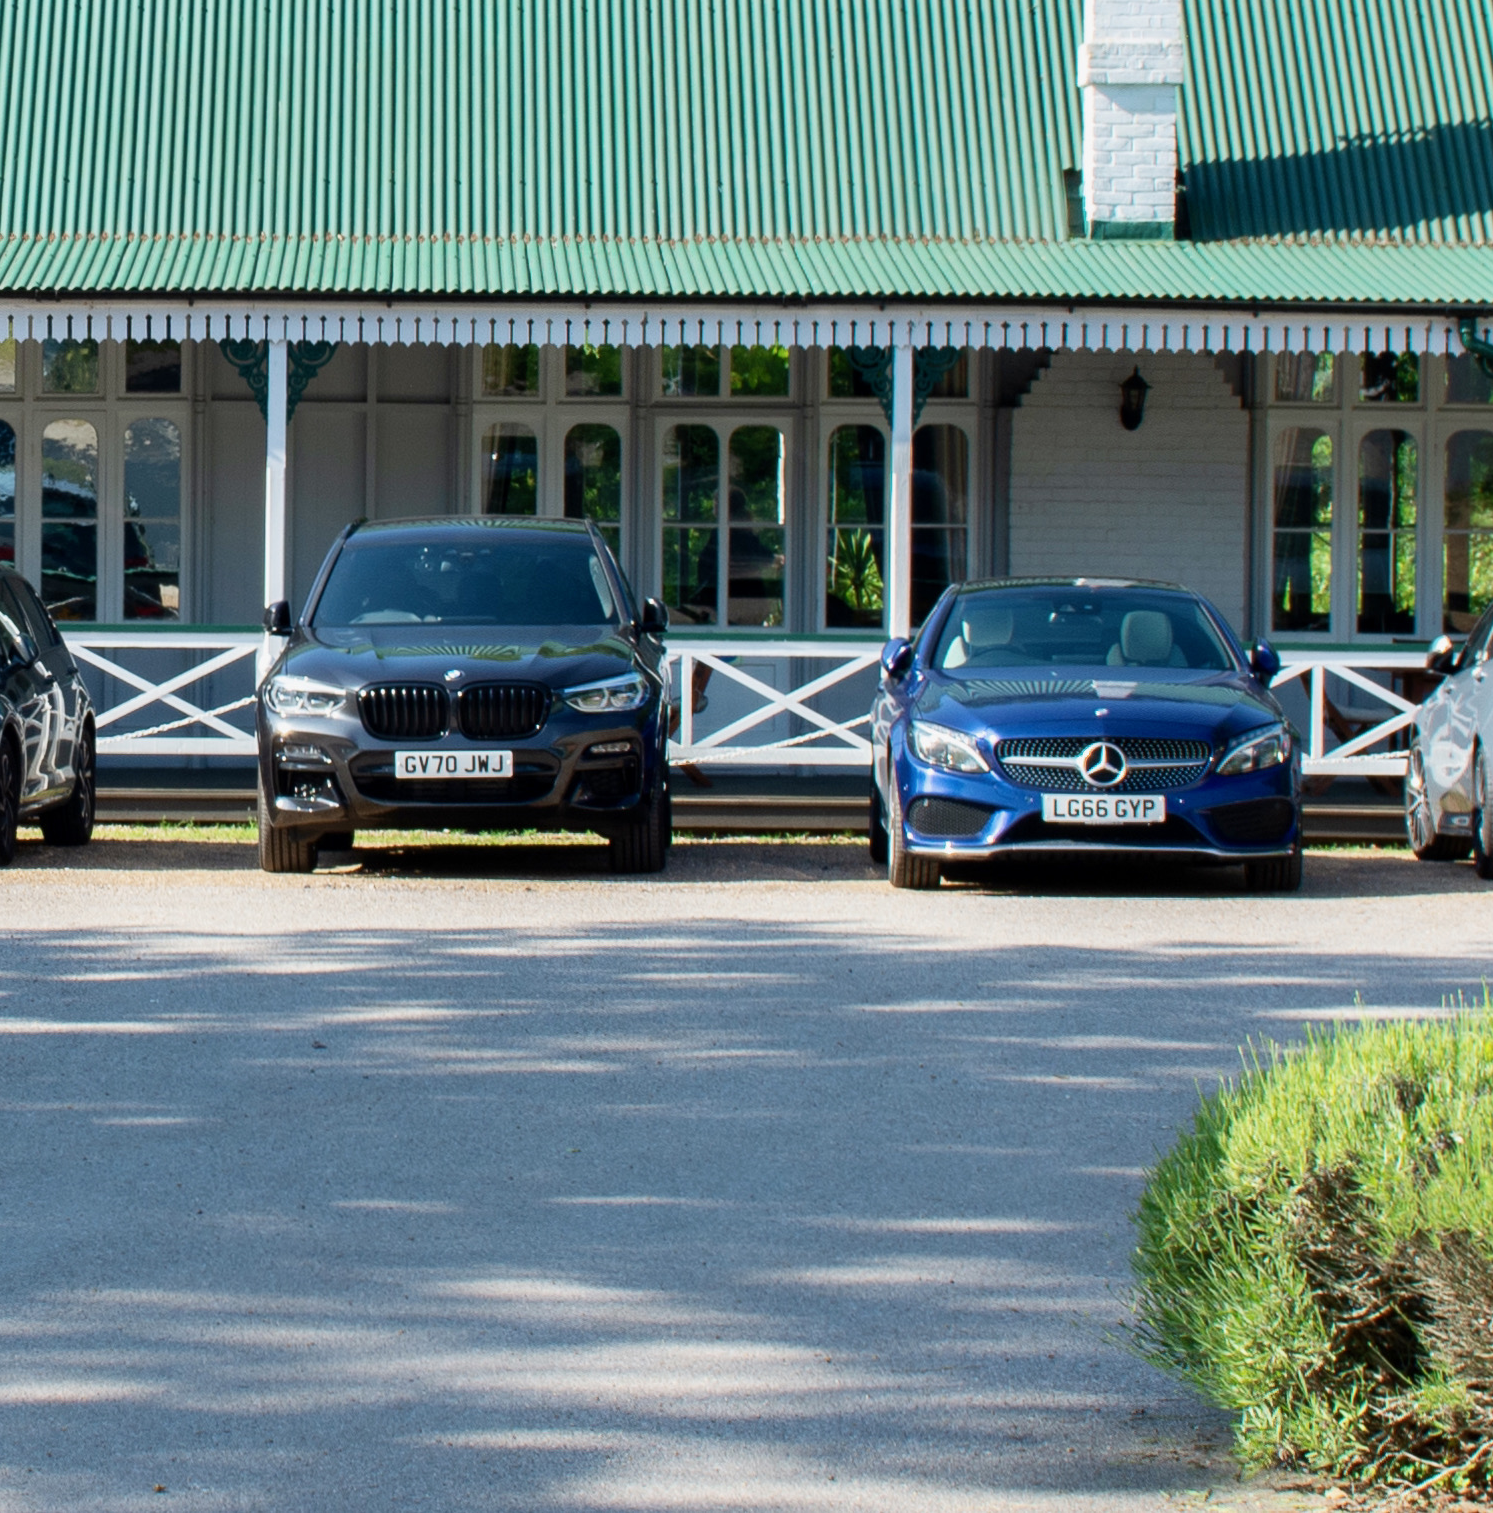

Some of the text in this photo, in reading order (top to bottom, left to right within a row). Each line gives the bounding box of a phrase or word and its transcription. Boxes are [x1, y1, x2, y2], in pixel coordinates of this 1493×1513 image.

[404, 756, 504, 773] GV70 JWJ
[1053, 798, 1156, 818] LG66 GYP
